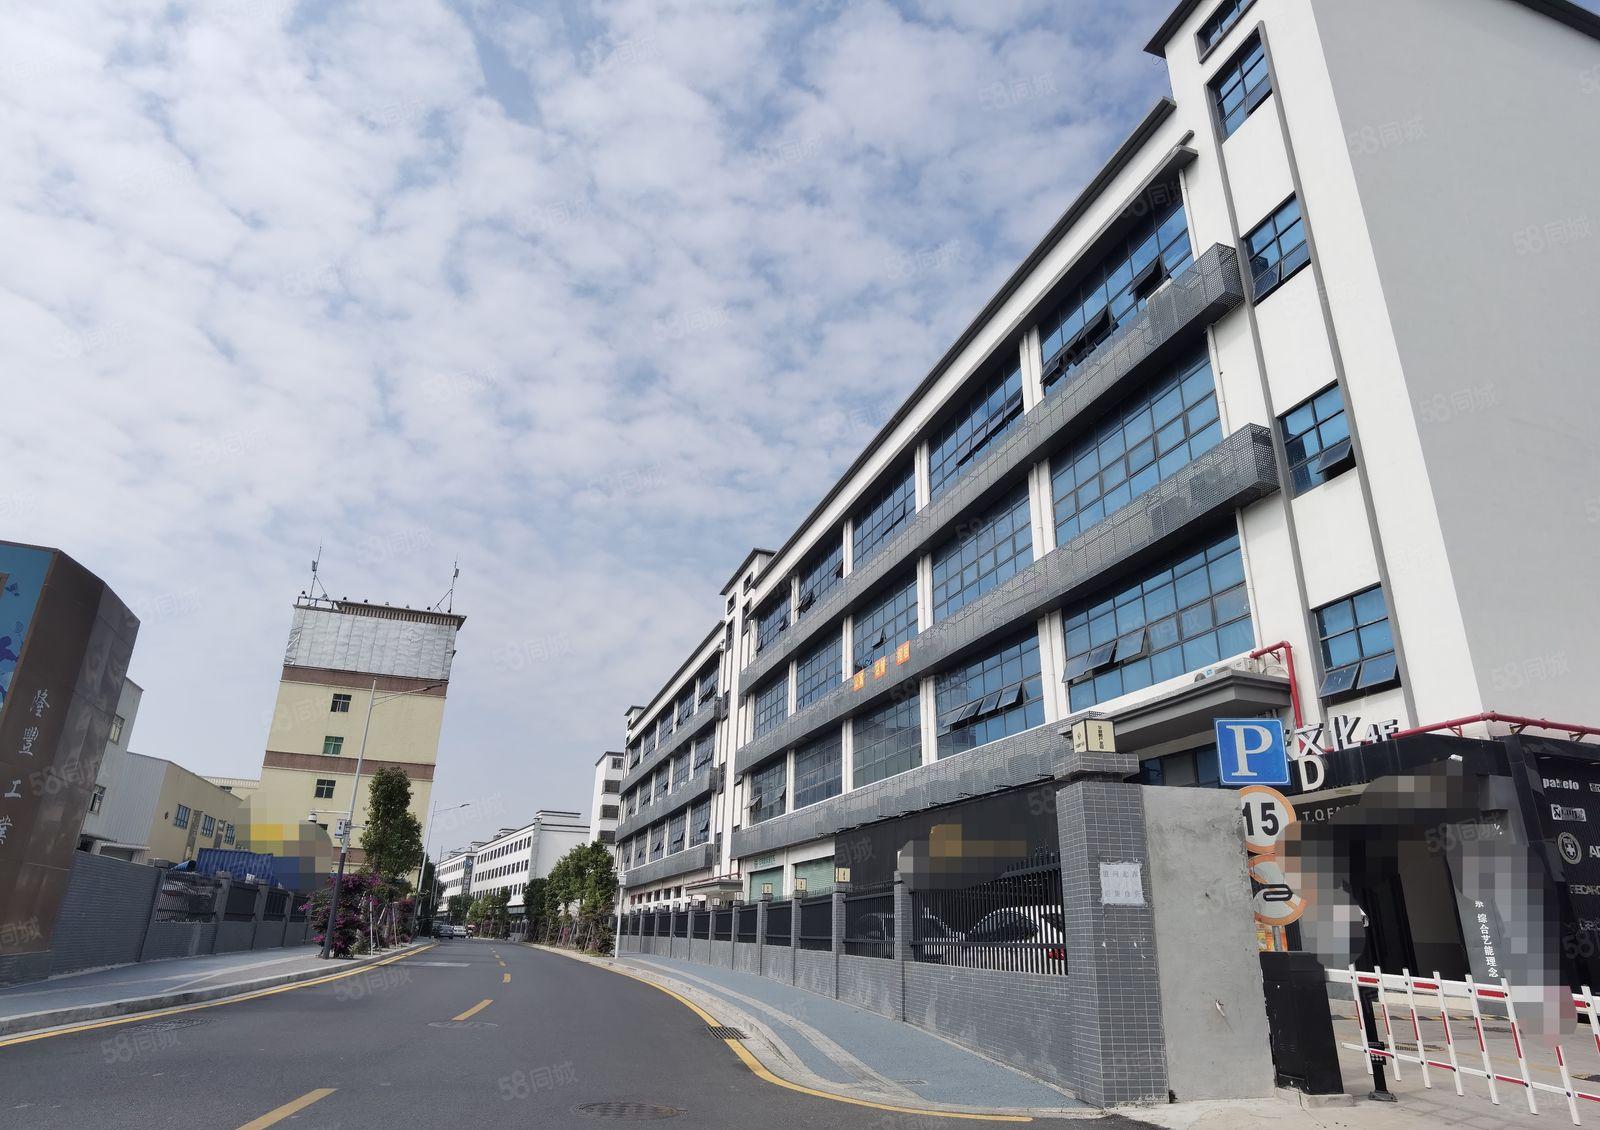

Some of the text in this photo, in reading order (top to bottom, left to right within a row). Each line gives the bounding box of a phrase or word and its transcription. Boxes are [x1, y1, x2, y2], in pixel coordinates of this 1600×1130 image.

[1226, 725, 1273, 776] P
[1242, 802, 1279, 836] 15
[1477, 913, 1499, 978] 综合艺能理念
